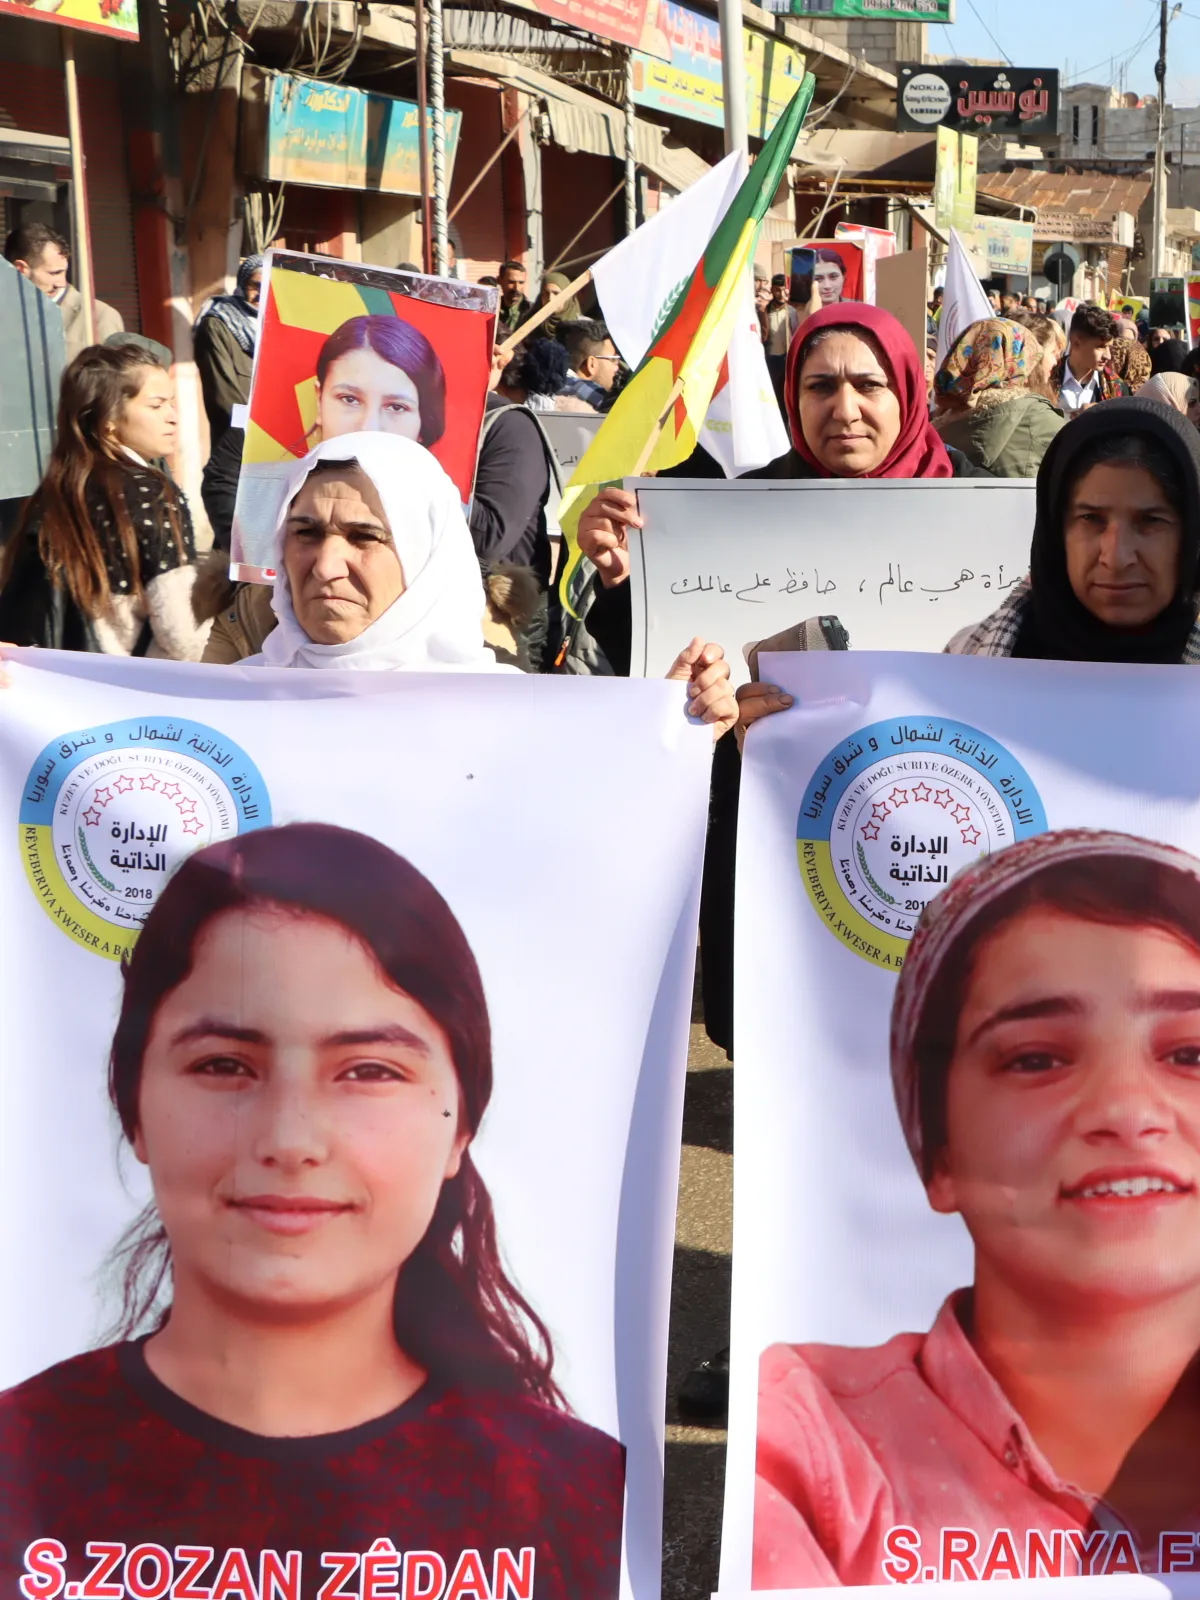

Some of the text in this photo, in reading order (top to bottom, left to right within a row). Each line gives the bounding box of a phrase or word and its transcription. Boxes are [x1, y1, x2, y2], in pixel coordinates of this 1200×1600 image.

[957, 72, 1048, 124] نوشين
[27, 758, 56, 803] سوريا
[804, 774, 832, 819] سوريا
[837, 795, 856, 831] KUZEY
[856, 781, 869, 795] VE
[111, 822, 168, 847] الإدارة
[890, 835, 948, 859] الإدارة
[110, 850, 166, 873] الذاتية
[889, 863, 948, 887] الذاتية
[25, 827, 56, 906] RÊVEBERIYA
[54, 906, 100, 948] XWESER
[101, 941, 110, 953] A
[125, 887, 153, 899] 2018
[803, 842, 836, 922] RÊVEBERIYA
[834, 921, 882, 959] XWESER
[882, 954, 891, 965] A
[320, 1537, 535, 1600] ZÊDAN
